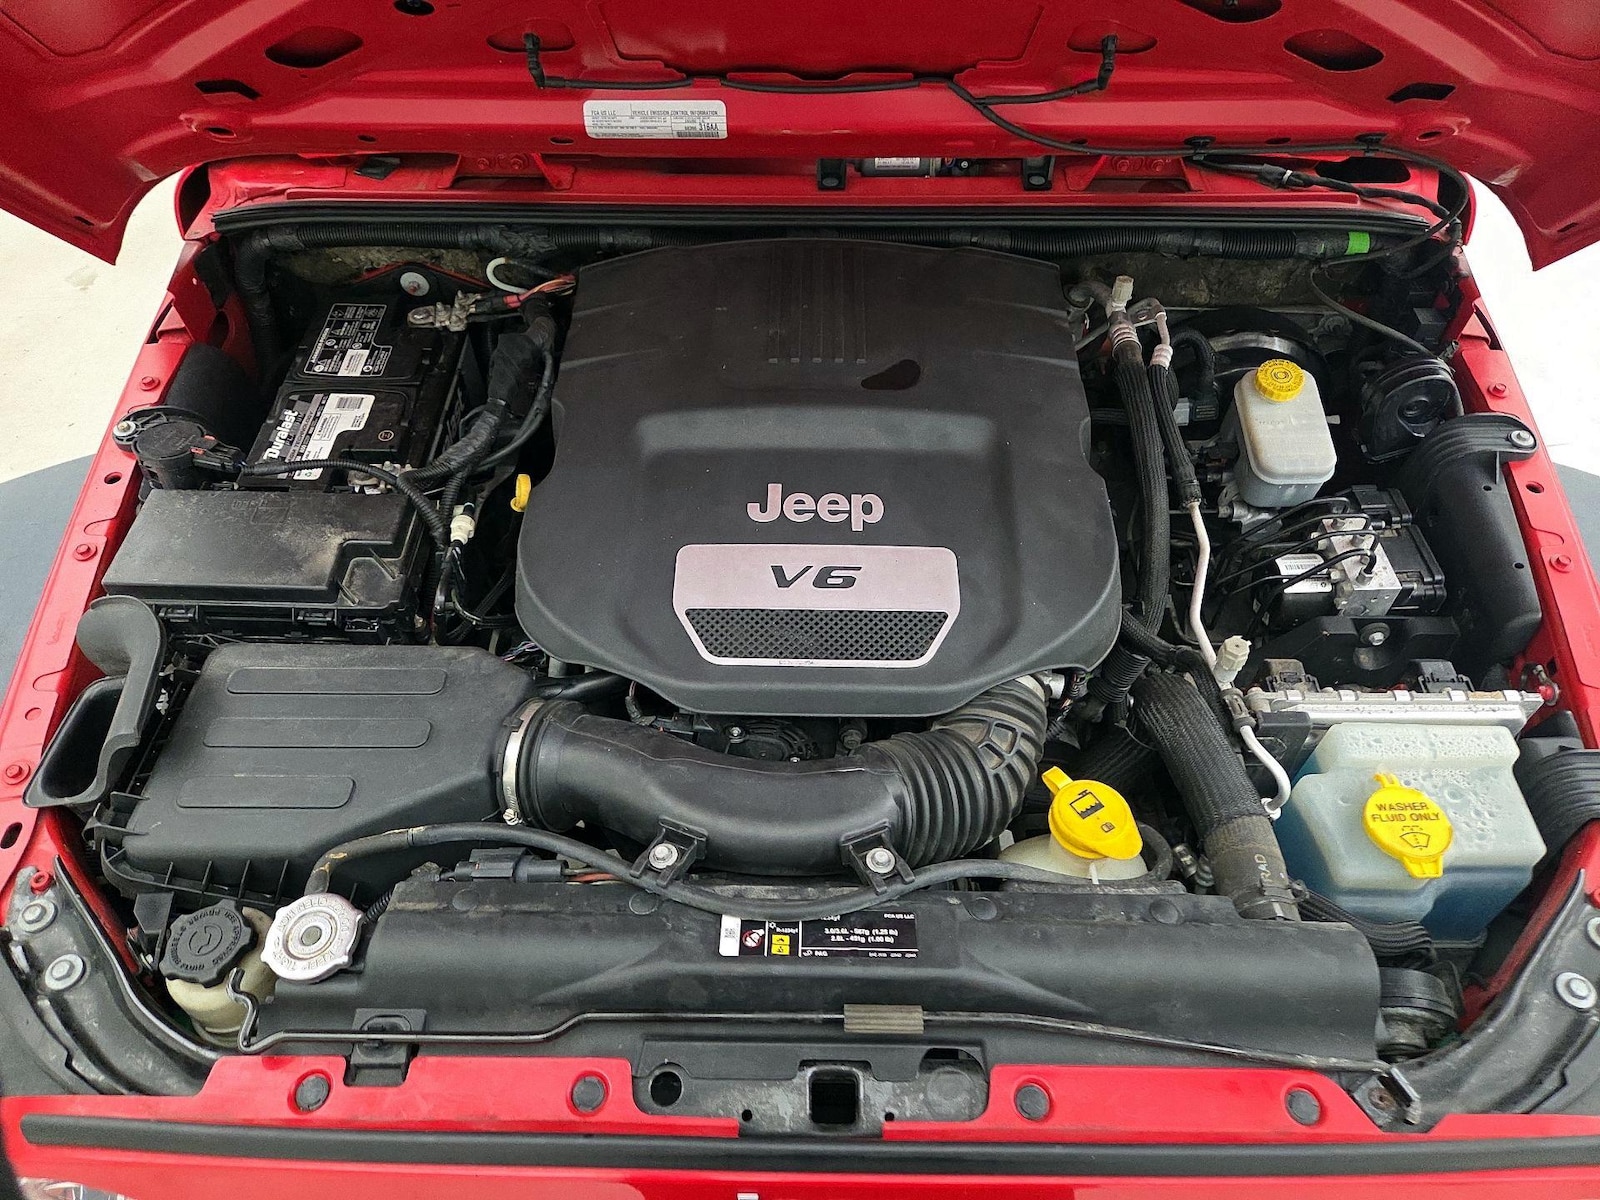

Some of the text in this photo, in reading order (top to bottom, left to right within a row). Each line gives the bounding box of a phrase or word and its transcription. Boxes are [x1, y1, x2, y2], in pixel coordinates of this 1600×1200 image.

[262, 408, 299, 460] Duralast
[294, 409, 314, 449] TECHNOLOGY
[746, 482, 884, 532] Jeep
[770, 565, 863, 589] V6
[1370, 811, 1441, 823] FLUID ONLY
[1375, 801, 1430, 812] WASHER
